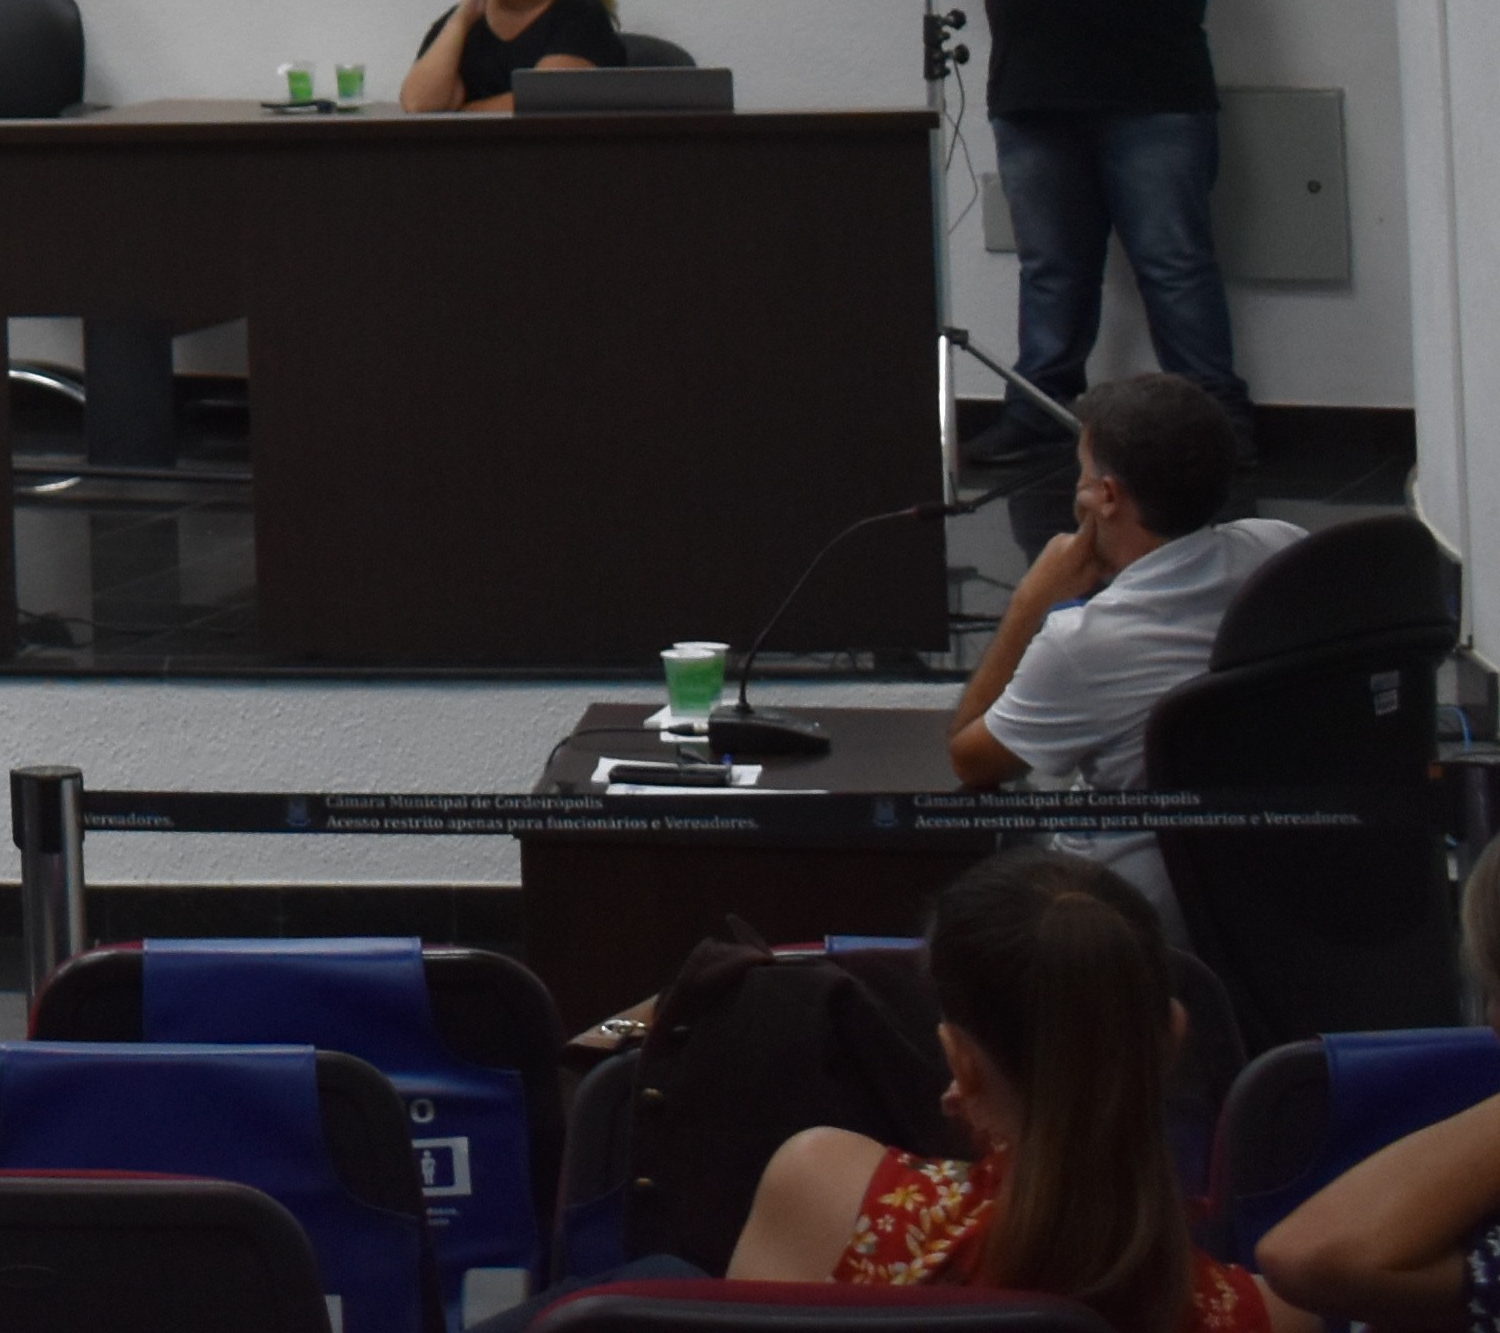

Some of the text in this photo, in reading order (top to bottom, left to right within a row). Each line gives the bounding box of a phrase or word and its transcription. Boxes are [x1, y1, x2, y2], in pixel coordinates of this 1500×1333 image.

[326, 795, 604, 812] Câmara Municipal de Cordeirópolis
[913, 790, 1202, 810] Câmara Municipal de Cordeirópolis
[326, 815, 759, 832] Acesso restrito apenas para funcionários e Vereadores.
[914, 811, 1363, 832] Acesso restrito apenas para funcionários e Vereadores.
